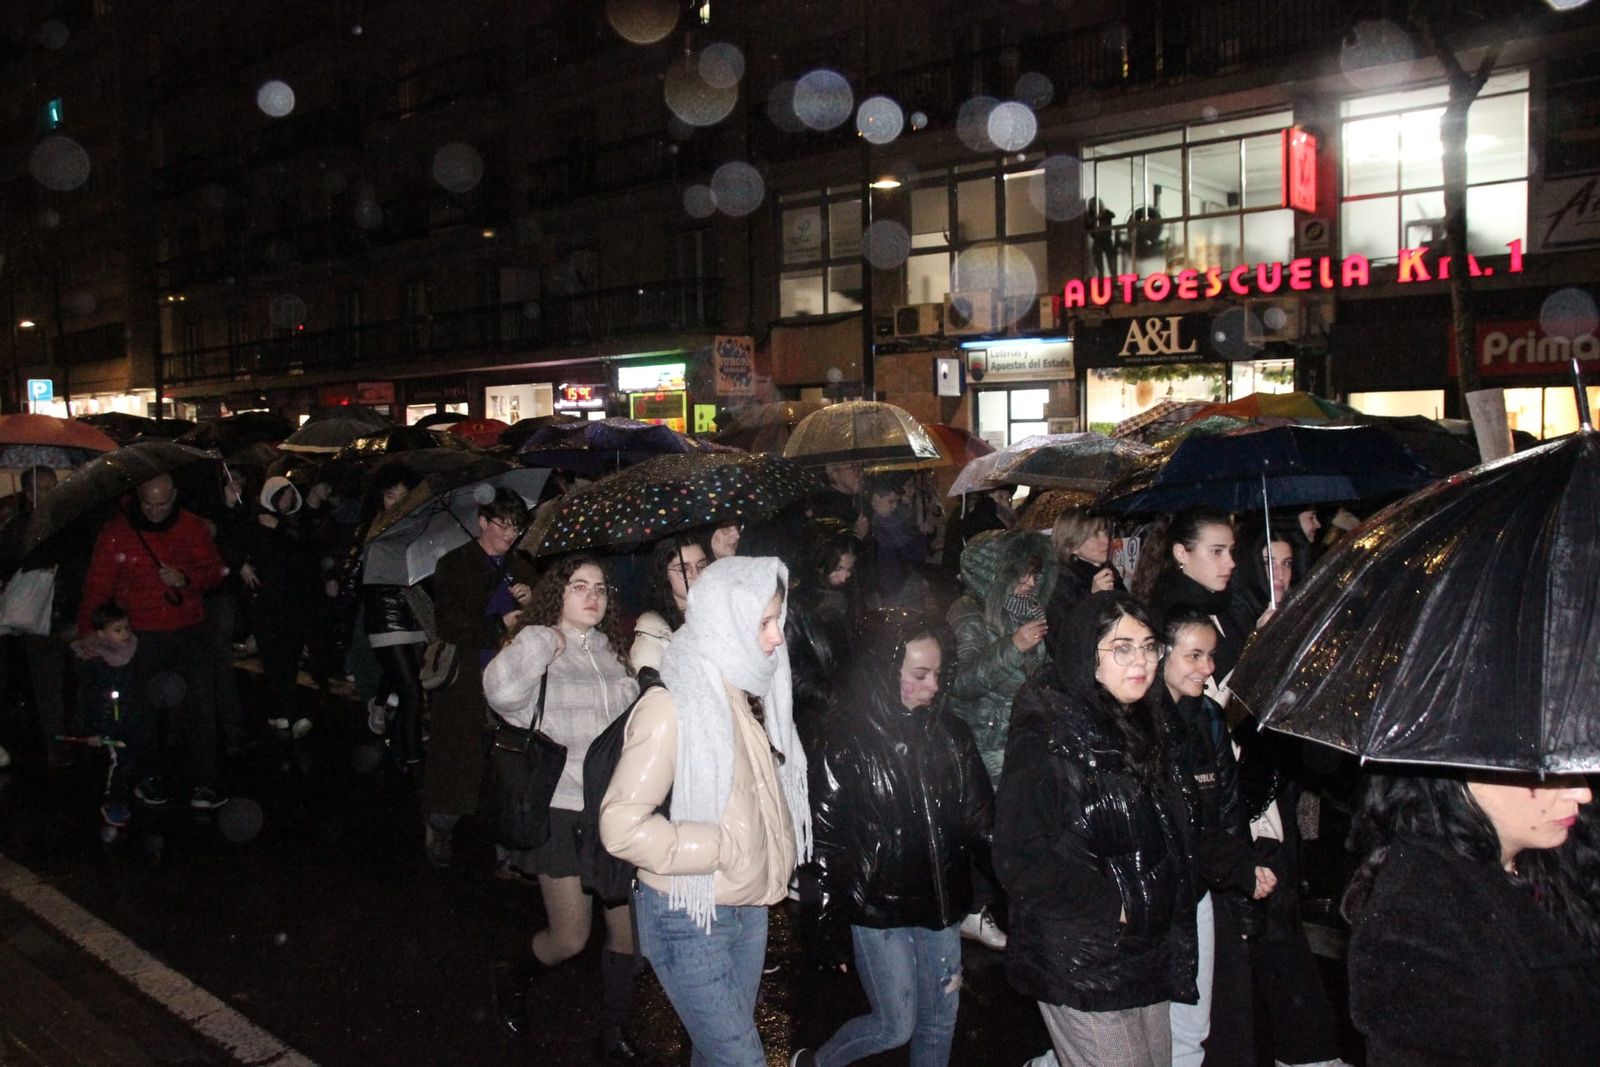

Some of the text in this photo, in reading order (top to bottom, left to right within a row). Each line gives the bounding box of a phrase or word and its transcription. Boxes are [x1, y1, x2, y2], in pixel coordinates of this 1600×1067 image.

[1064, 253, 1370, 308] AUTOESCUELA
[1118, 316, 1197, 356] A&L
[990, 358, 1071, 372] Apuestas del Estado
[32, 382, 48, 400] P
